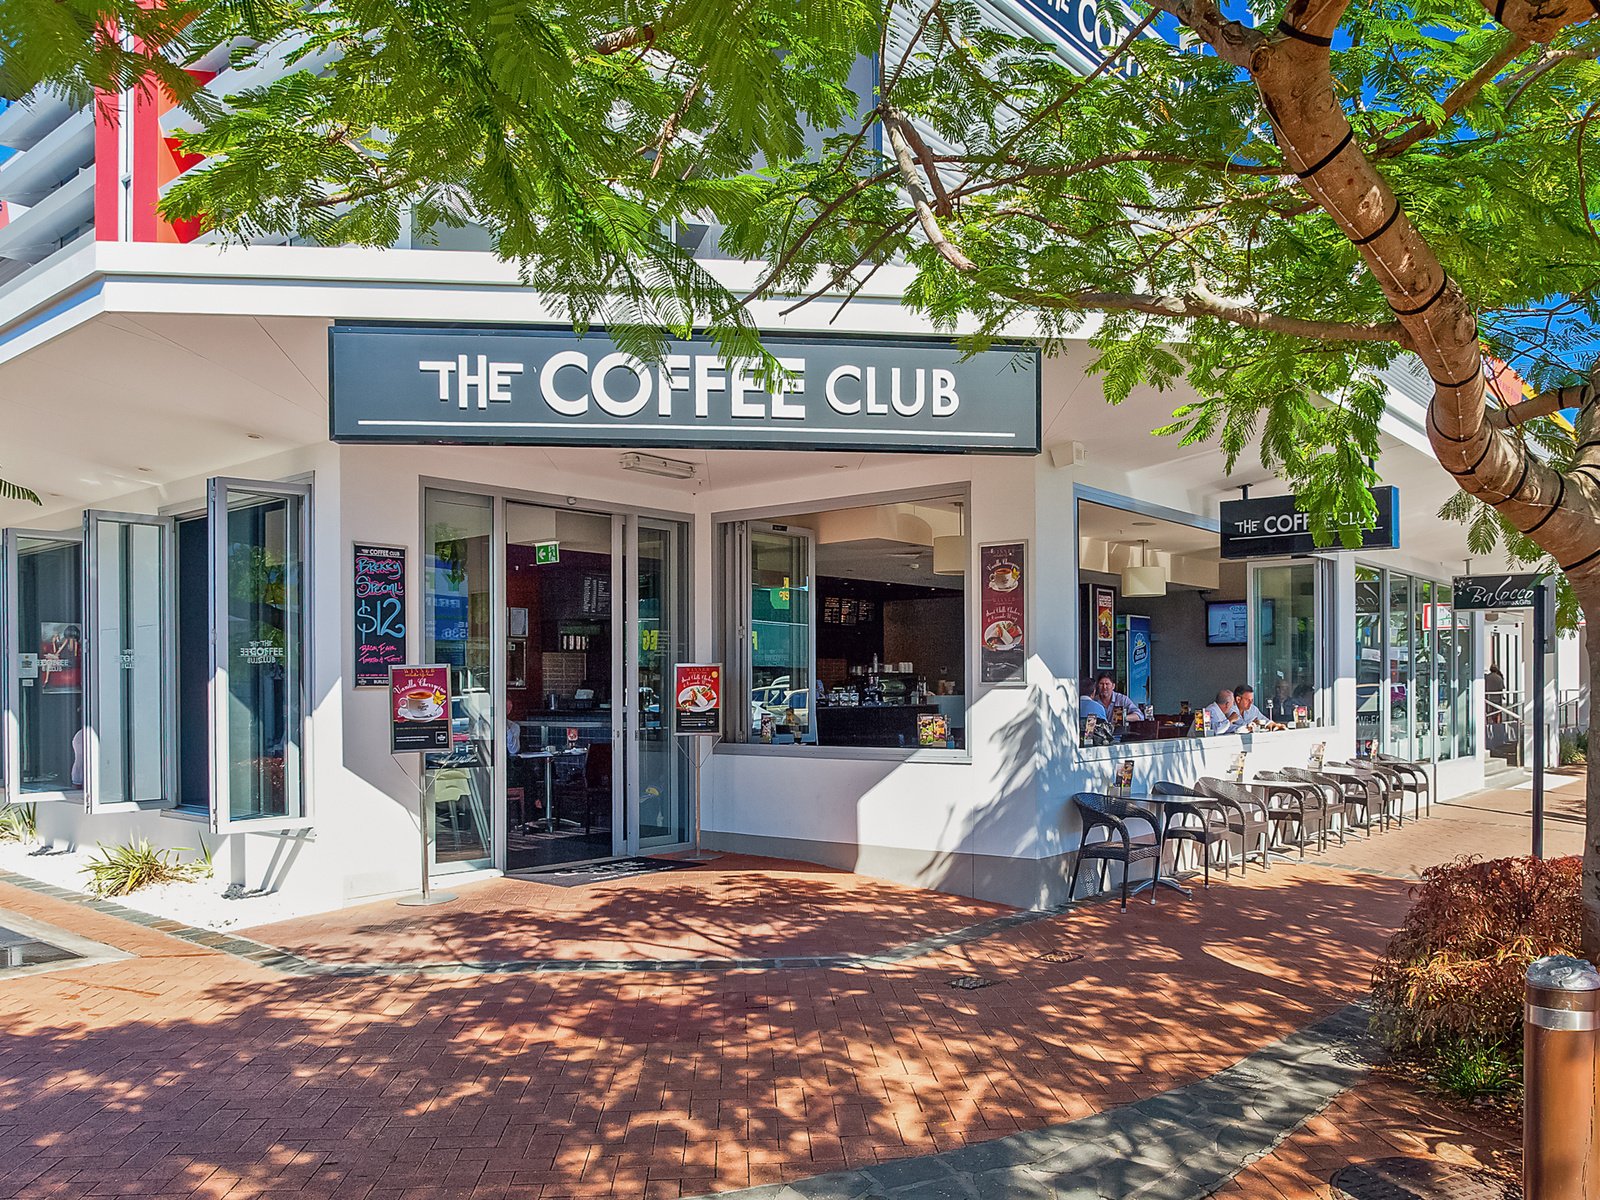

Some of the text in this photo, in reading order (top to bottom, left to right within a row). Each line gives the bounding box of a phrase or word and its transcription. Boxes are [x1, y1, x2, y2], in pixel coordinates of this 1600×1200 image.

[419, 350, 960, 419] THE COFFEE CLUB
[1234, 519, 1260, 534] THE
[369, 549, 389, 557] COFFEE
[1466, 576, 1535, 607] Balocco
[357, 597, 406, 645] $12
